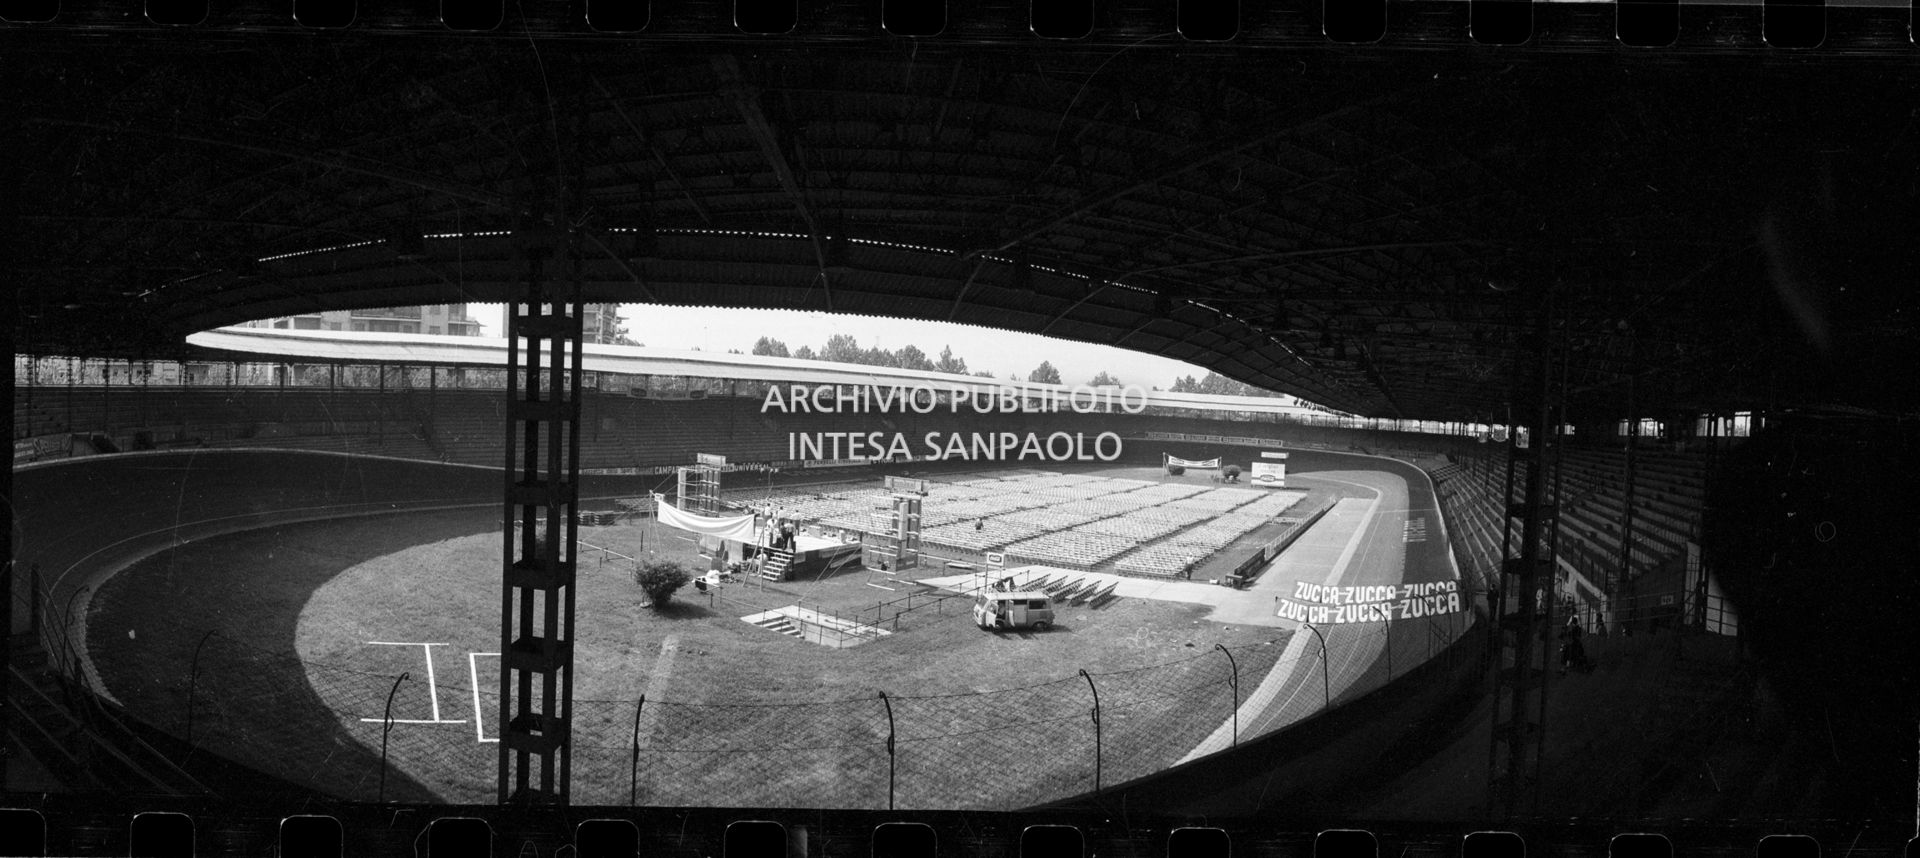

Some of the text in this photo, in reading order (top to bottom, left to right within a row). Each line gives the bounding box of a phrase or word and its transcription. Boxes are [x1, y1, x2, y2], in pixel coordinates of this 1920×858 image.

[1294, 580, 1457, 604] ZUCCA ZUCCA ZUCCA
[1277, 592, 1460, 623] ZUCCA ZUCCA ZUCCA
